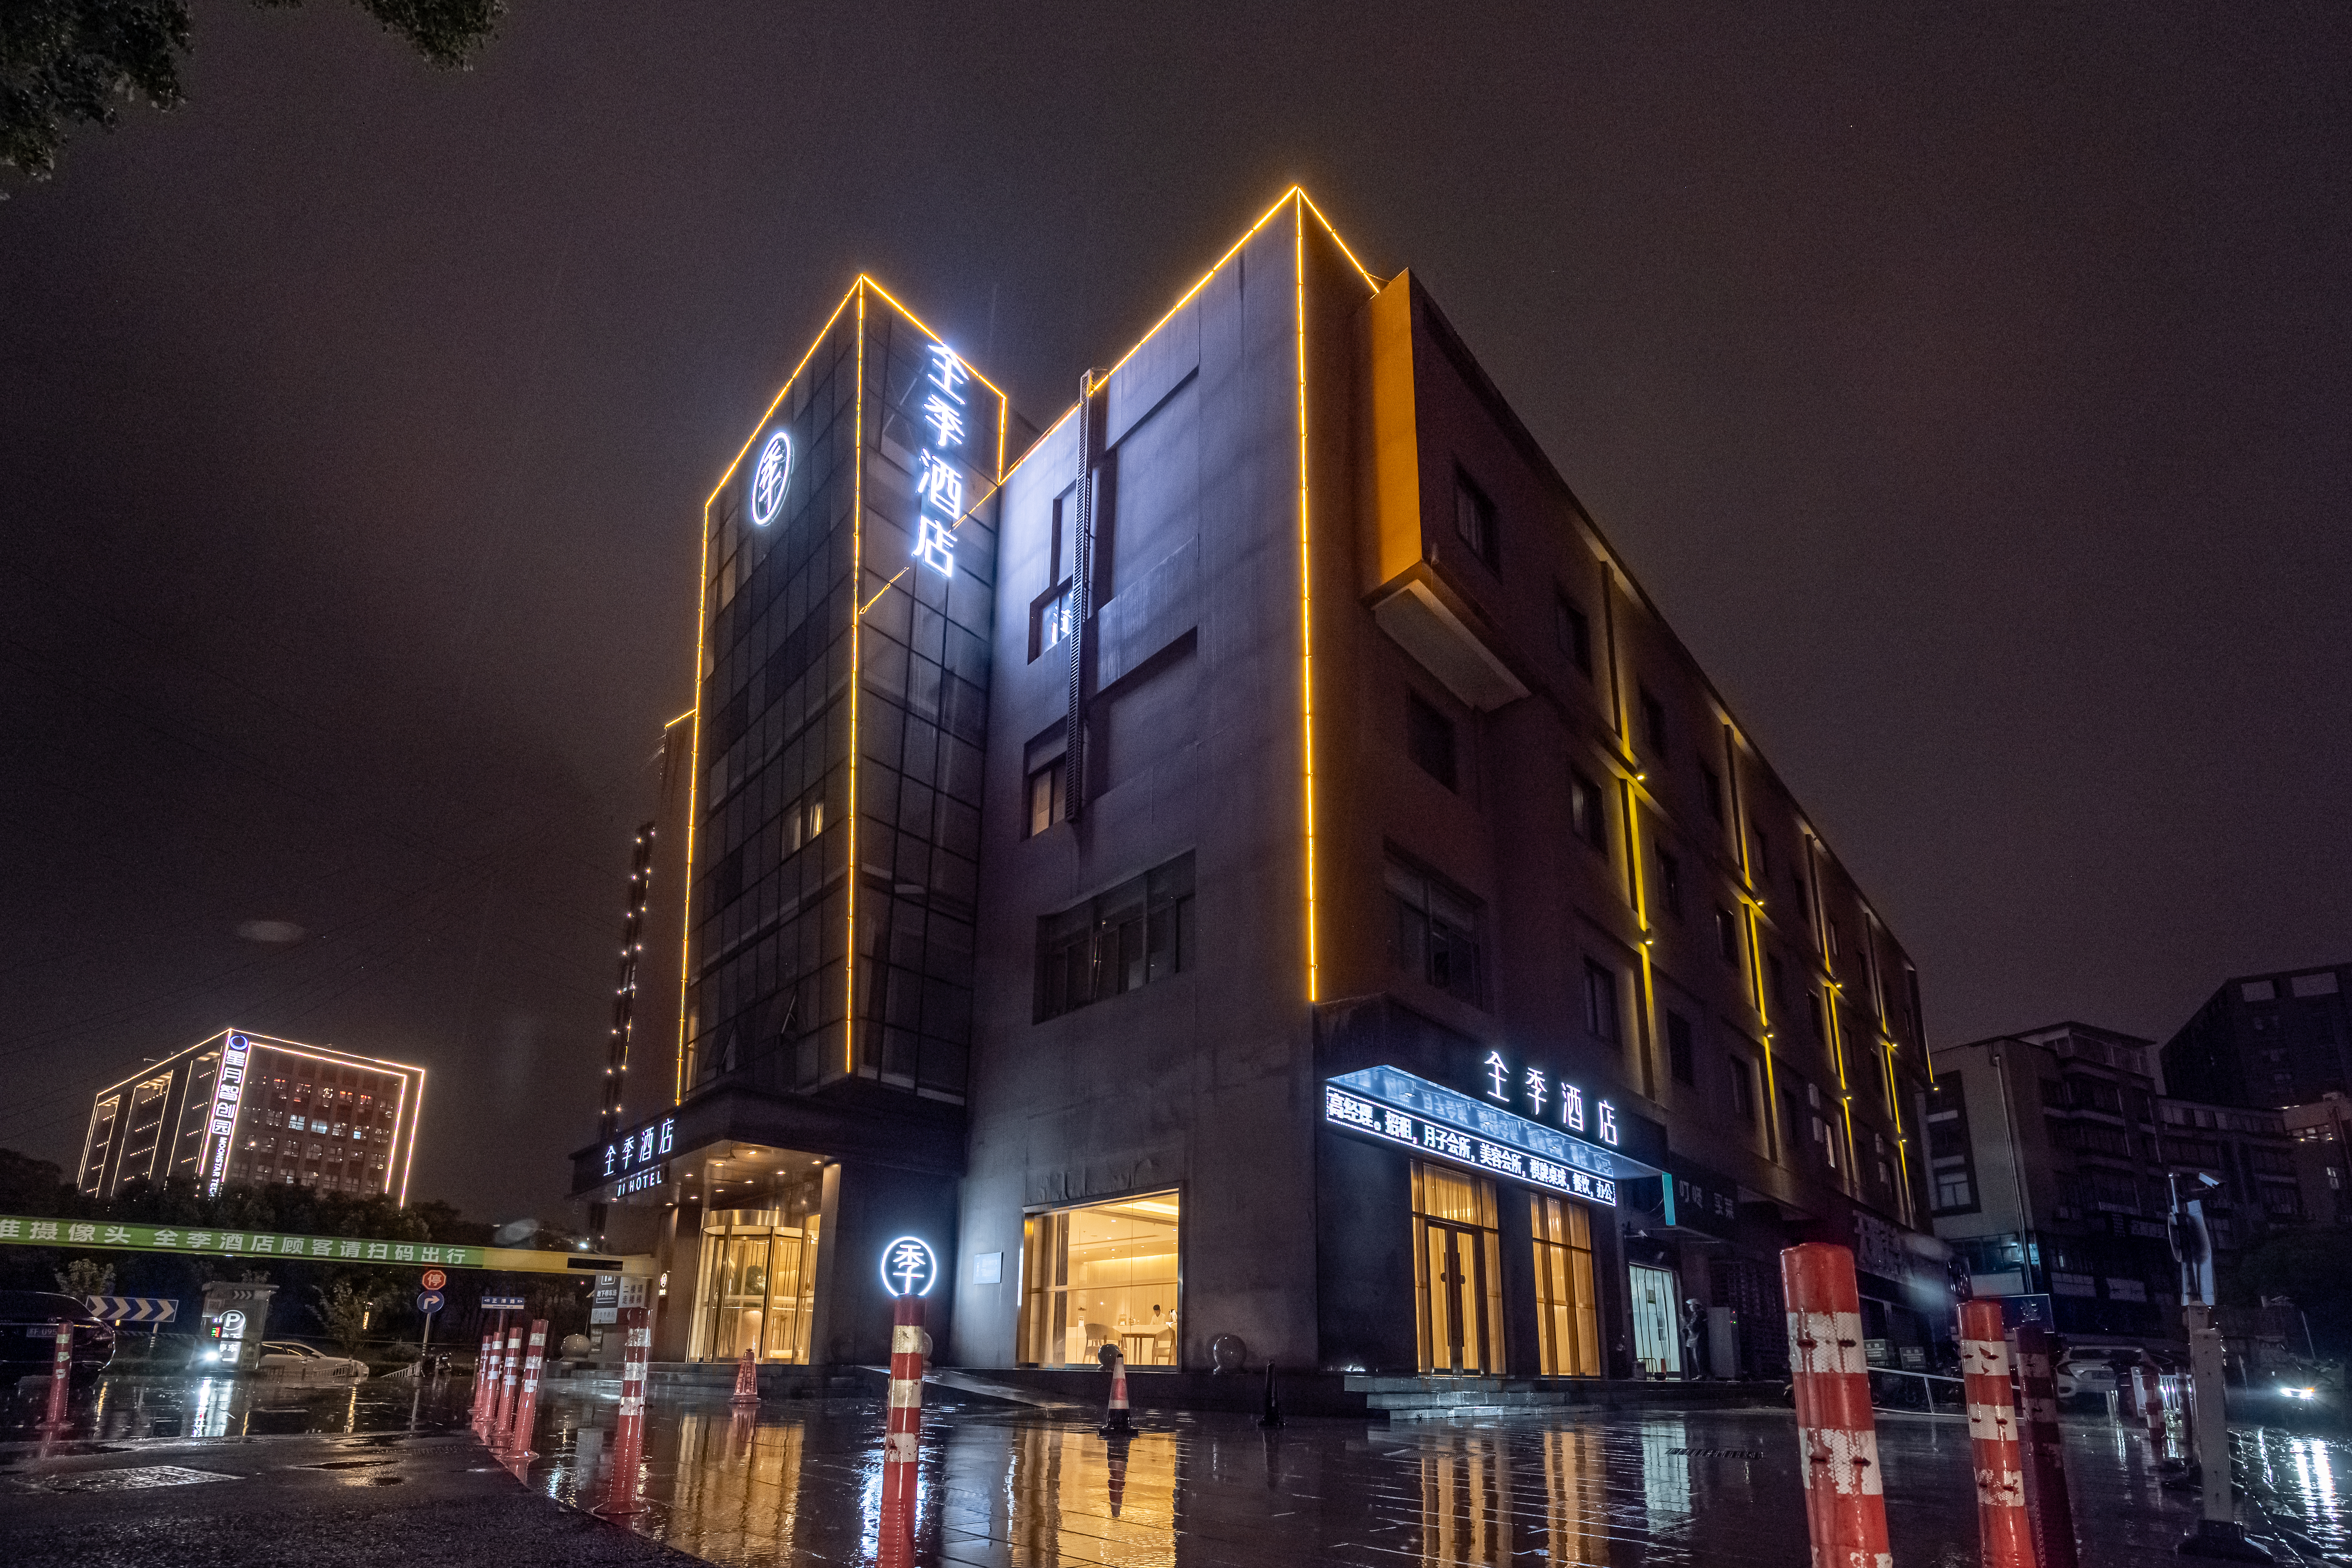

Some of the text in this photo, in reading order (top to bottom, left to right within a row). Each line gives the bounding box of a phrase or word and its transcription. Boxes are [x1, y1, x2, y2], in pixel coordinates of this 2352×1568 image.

[912, 344, 969, 577] 全季酒店
[212, 1050, 246, 1135] 星月智创园
[1484, 1051, 1619, 1146] 全季酒店
[212, 1136, 228, 1177] MOONSTAR
[603, 1118, 674, 1176] 全季酒店
[617, 1171, 662, 1197] JI HOTEL
[153, 1230, 465, 1265] 全季酒店顾客请扫码出行
[427, 1274, 442, 1286] 停
[225, 1313, 240, 1327] P
